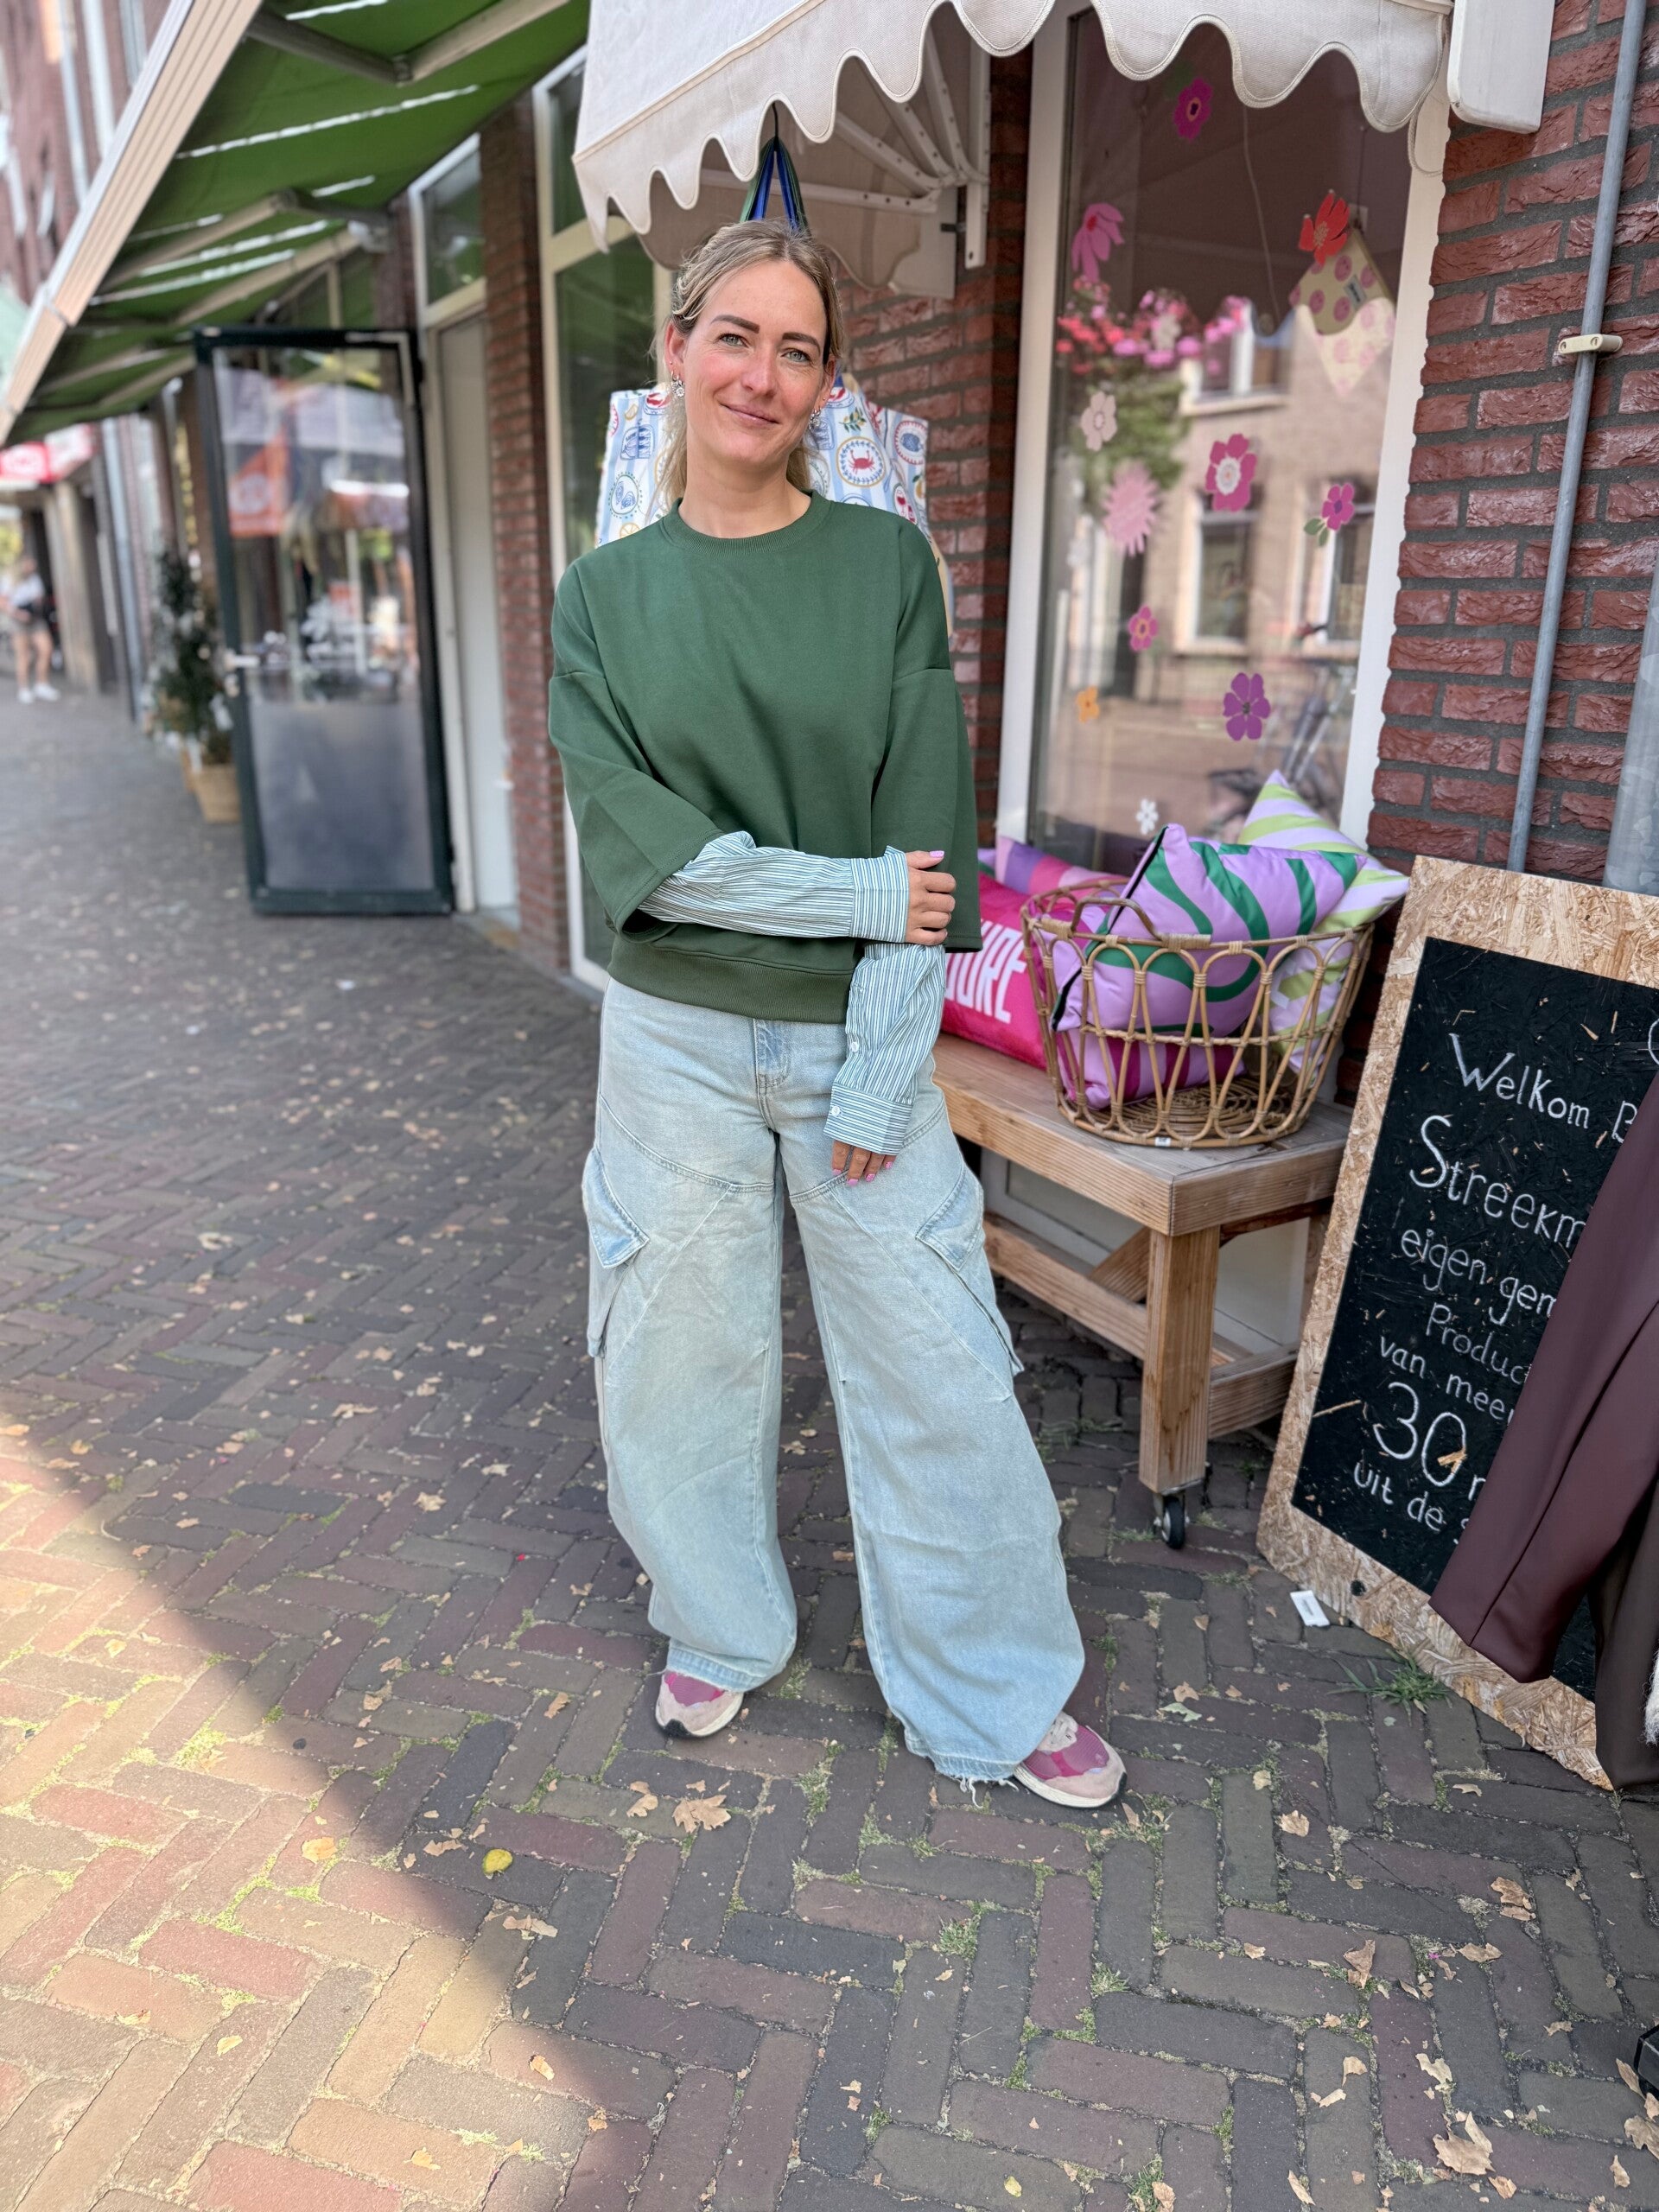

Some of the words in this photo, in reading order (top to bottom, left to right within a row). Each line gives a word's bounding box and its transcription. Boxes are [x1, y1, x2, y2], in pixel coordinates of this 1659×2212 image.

[1448, 1033, 1590, 1129] Welkom
[1401, 1229, 1486, 1292] eigen
[1381, 1337, 1427, 1379] van
[1372, 1382, 1467, 1486] 30
[1407, 1491, 1443, 1532] de
